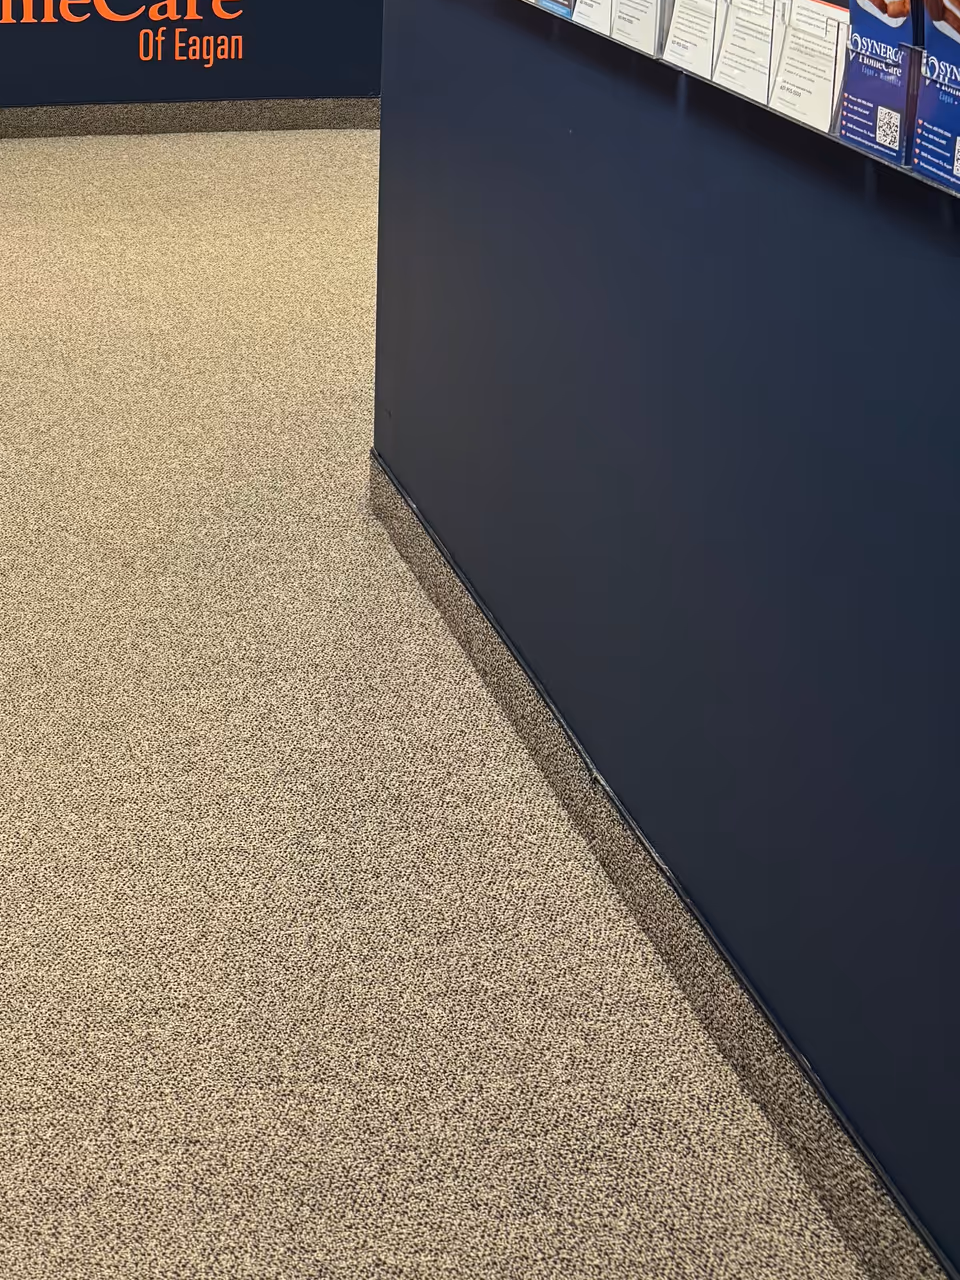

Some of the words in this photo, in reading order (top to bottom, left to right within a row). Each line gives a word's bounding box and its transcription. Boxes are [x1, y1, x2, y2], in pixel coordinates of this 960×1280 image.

[139, 26, 166, 62] Of
[174, 27, 244, 68] Eagan
[861, 36, 905, 64] SYNERGY
[859, 51, 902, 77] HomeCare
